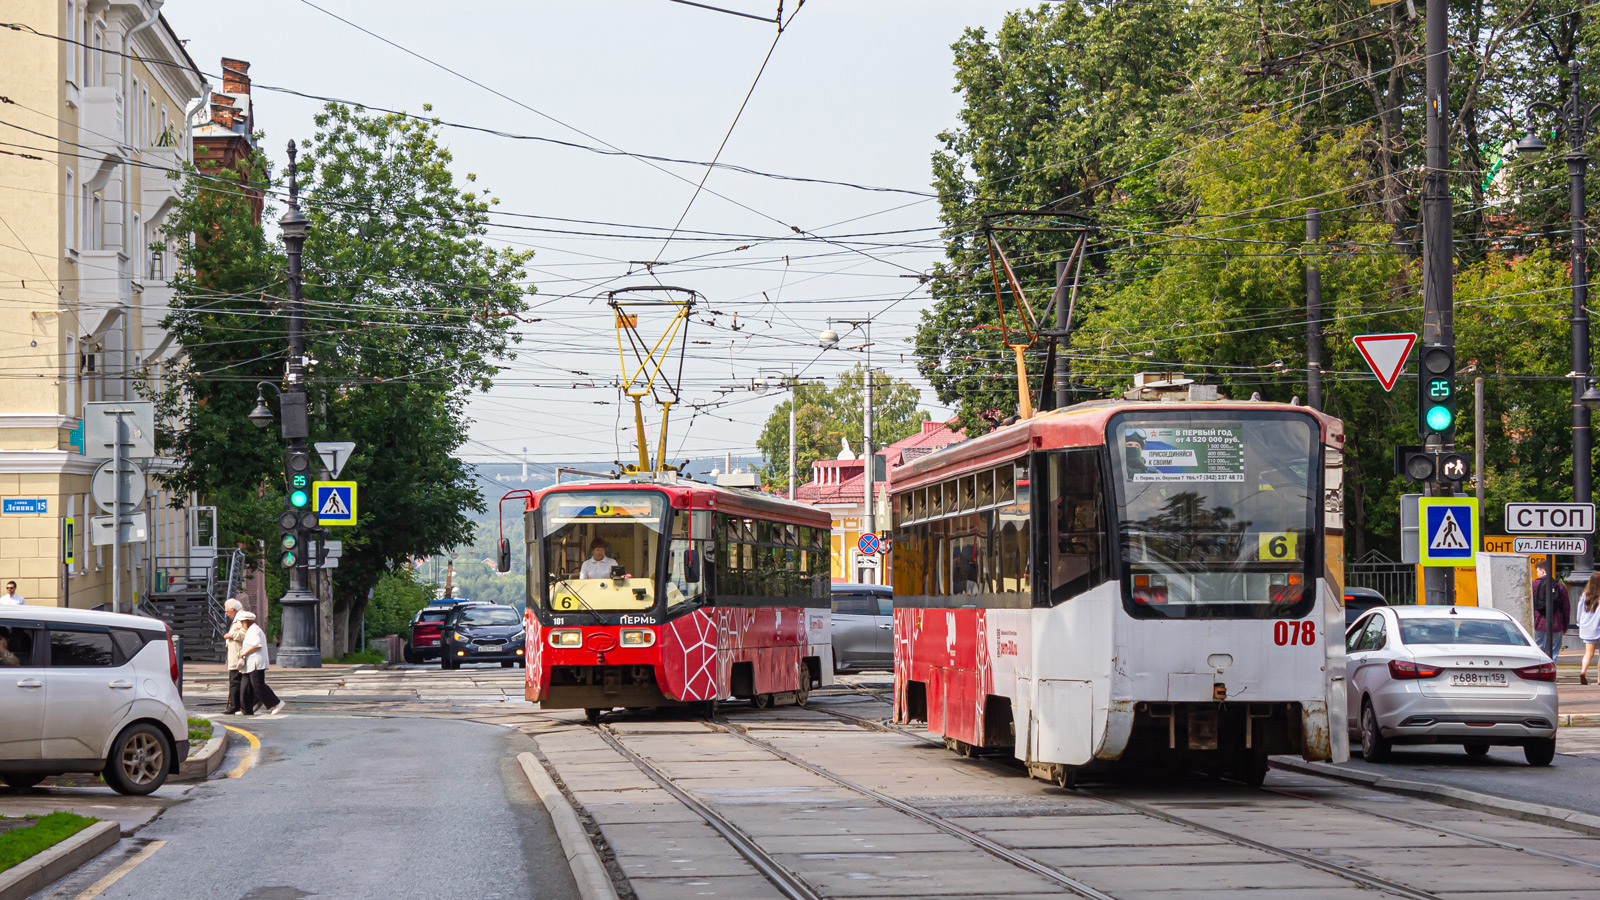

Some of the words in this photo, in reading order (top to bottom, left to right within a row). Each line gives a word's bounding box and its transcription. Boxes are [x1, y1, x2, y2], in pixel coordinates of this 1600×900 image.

[1431, 381, 1449, 397] 25
[1182, 428, 1216, 436] ПЕРВЫЙ
[1217, 429, 1233, 437] ГОД
[1224, 436, 1240, 444] руб.
[1148, 450, 1193, 458] ПРИСОЕДИНЯЙСЯ
[293, 475, 306, 486] 25
[37, 502, 46, 511] 15
[600, 499, 610, 513] 6
[1517, 508, 1584, 528] СТОП
[1269, 536, 1288, 558] 6
[561, 597, 572, 609] 6
[553, 617, 564, 625] 101
[619, 616, 656, 625] ПЕРМЬ
[1274, 620, 1316, 646] 078
[1491, 673, 1505, 681] 159
